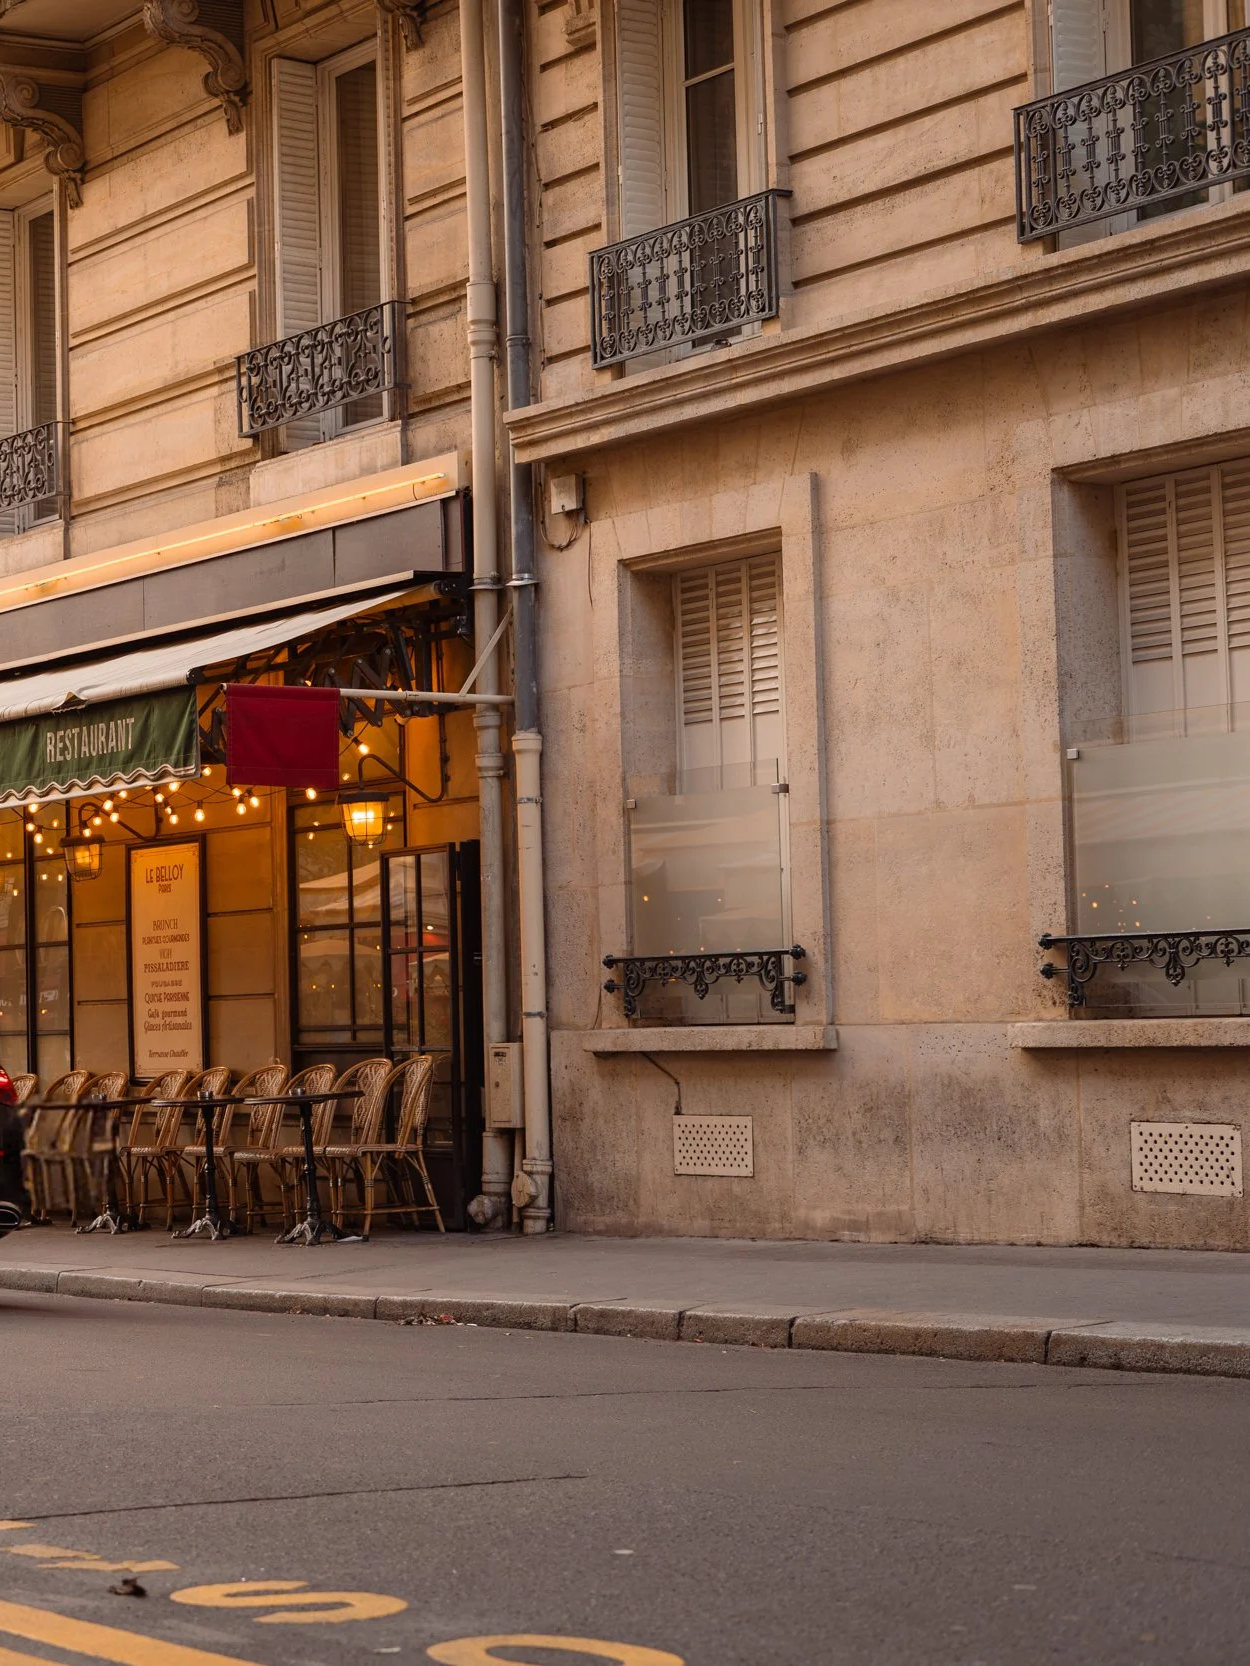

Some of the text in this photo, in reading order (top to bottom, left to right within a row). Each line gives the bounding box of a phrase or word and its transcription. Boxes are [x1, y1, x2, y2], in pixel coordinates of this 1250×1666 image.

[46, 717, 135, 763] RESTAURANT
[145, 863, 184, 884] LE BELLOY
[158, 883, 172, 893] PARIS
[152, 918, 178, 932] BRUNCH
[143, 961, 190, 974] PISSALADIERE
[144, 991, 190, 1005] QUICHE PARISIENNE
[161, 1008, 188, 1020] gourmand
[143, 1019, 192, 1034] Glaces Artisanales
[148, 1049, 169, 1058] Terrasse
